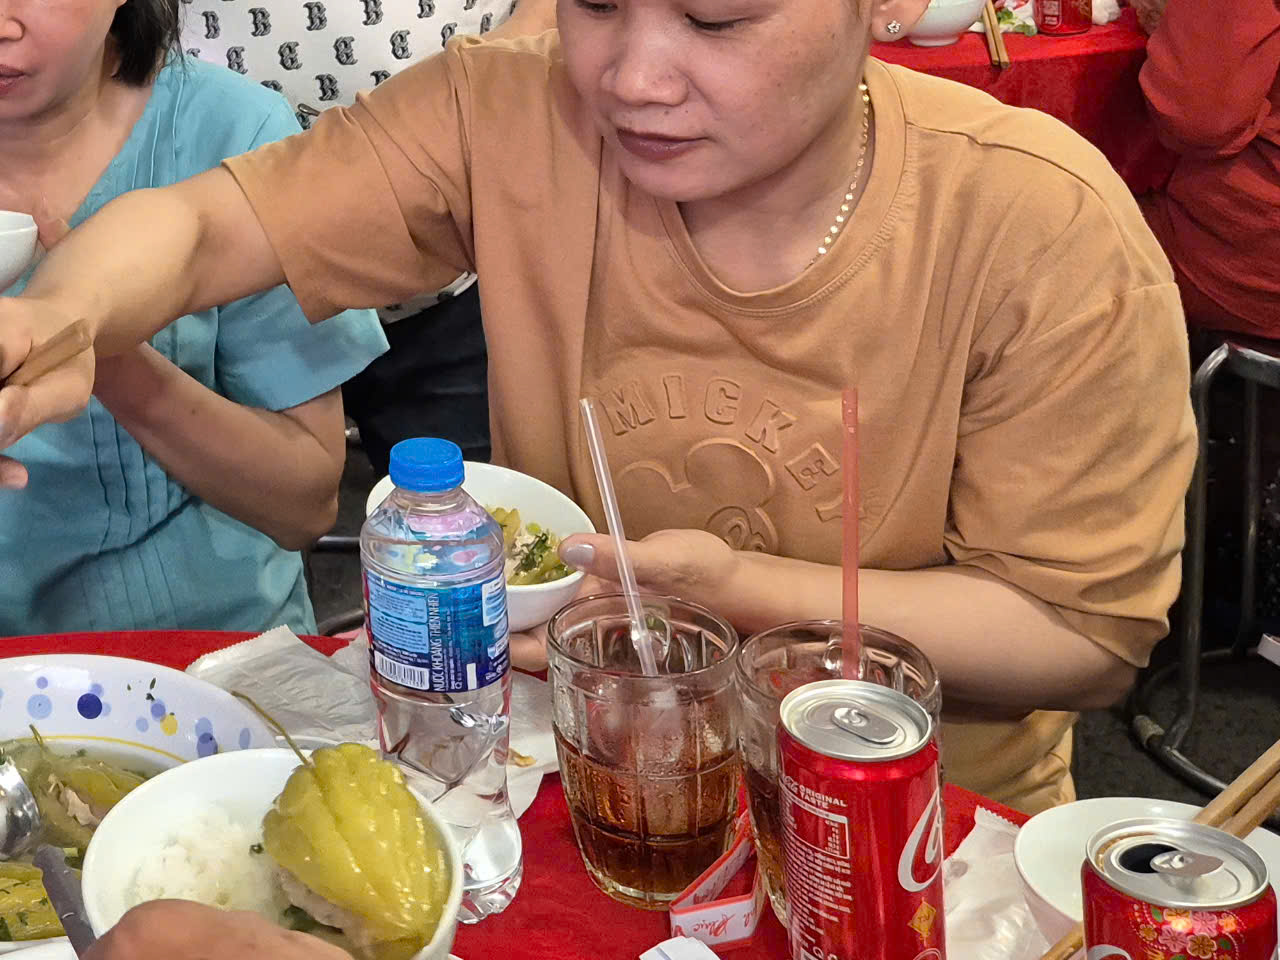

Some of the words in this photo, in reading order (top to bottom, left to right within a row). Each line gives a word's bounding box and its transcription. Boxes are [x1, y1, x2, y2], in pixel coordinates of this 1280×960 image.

[202, 11, 220, 39] B
[248, 8, 271, 37] B
[303, 2, 327, 31] B
[799, 784, 848, 808] ORIGINAL
[799, 791, 829, 809] TASTE
